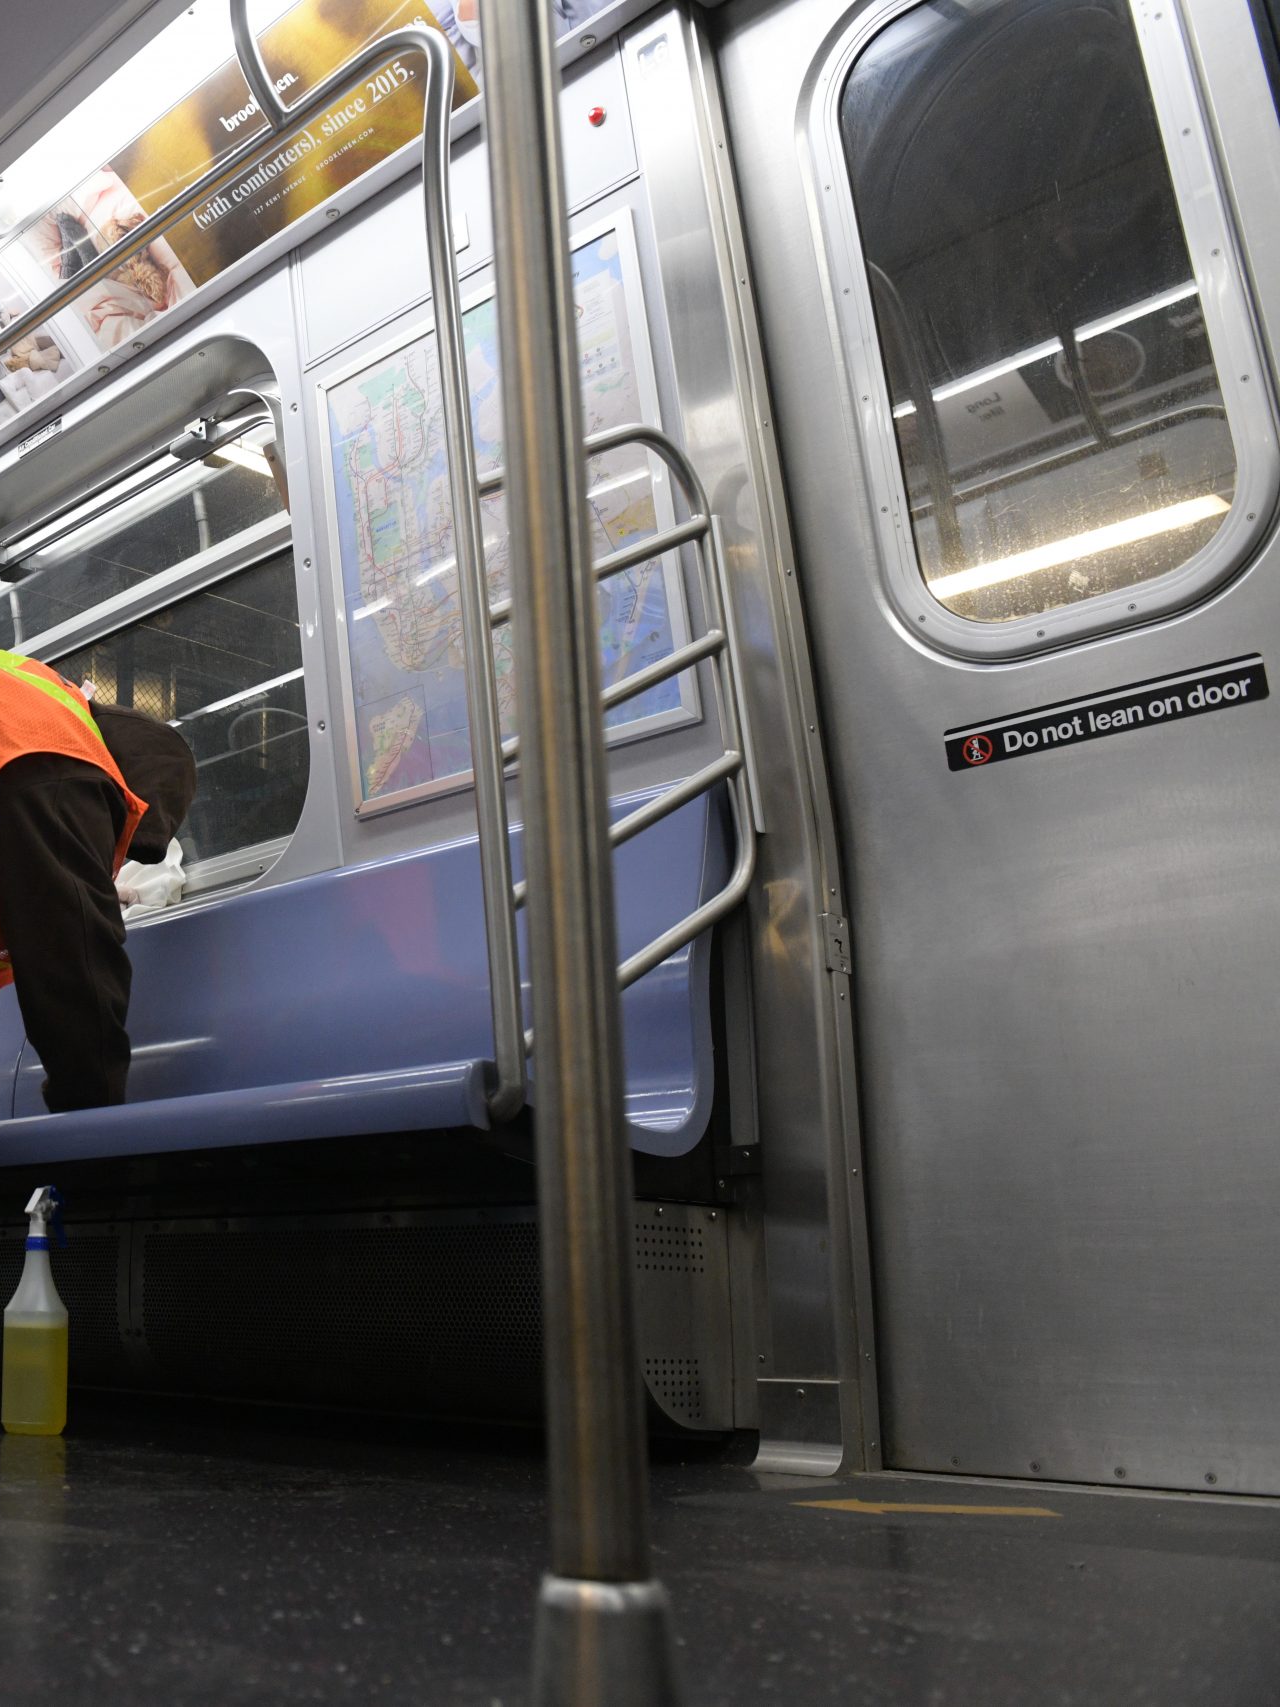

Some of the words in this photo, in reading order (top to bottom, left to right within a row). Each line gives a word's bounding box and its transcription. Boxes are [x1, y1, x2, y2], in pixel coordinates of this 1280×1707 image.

[192, 194, 232, 231] (with
[231, 128, 322, 203] comforters),
[320, 96, 367, 137] since
[366, 61, 416, 103] 2015.
[264, 193, 282, 207] KENT
[282, 174, 307, 195] AVENUE
[315, 127, 375, 171] BROOKLINEN.COM
[1002, 730, 1039, 753] Do
[1042, 716, 1084, 744] not
[1088, 705, 1145, 733] lean
[1148, 695, 1183, 718] on
[1187, 677, 1252, 709] door
